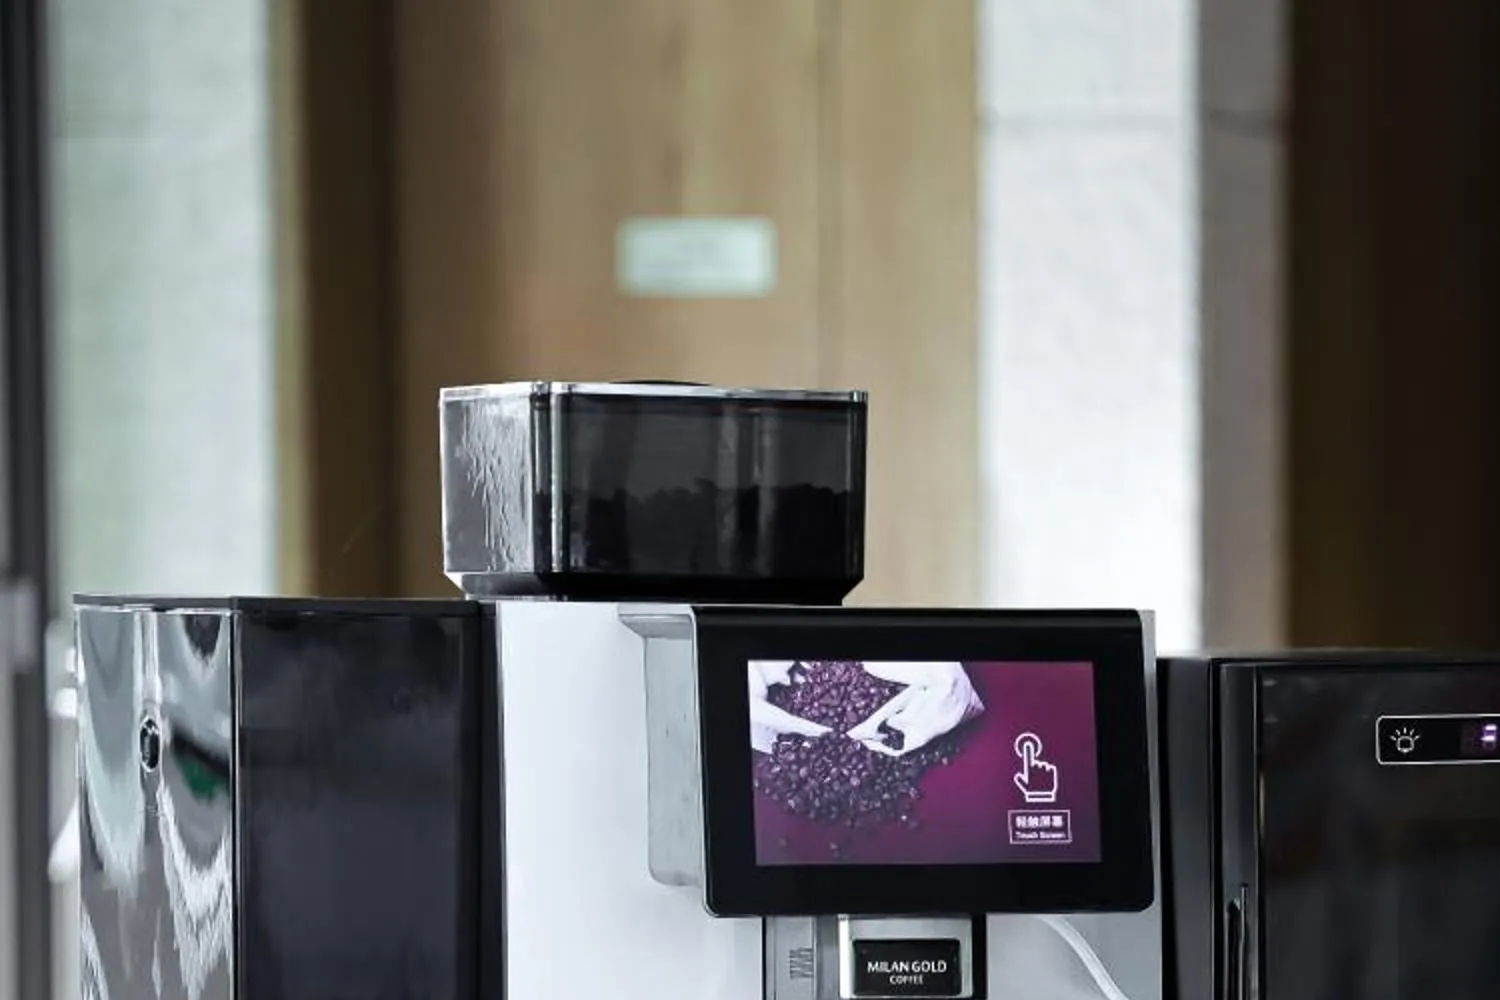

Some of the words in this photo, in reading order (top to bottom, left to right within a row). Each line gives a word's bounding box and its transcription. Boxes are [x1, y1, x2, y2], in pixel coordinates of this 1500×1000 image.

[867, 960, 909, 974] MILAN
[911, 959, 947, 973] GOLD
[889, 974, 923, 986] COFFEE
